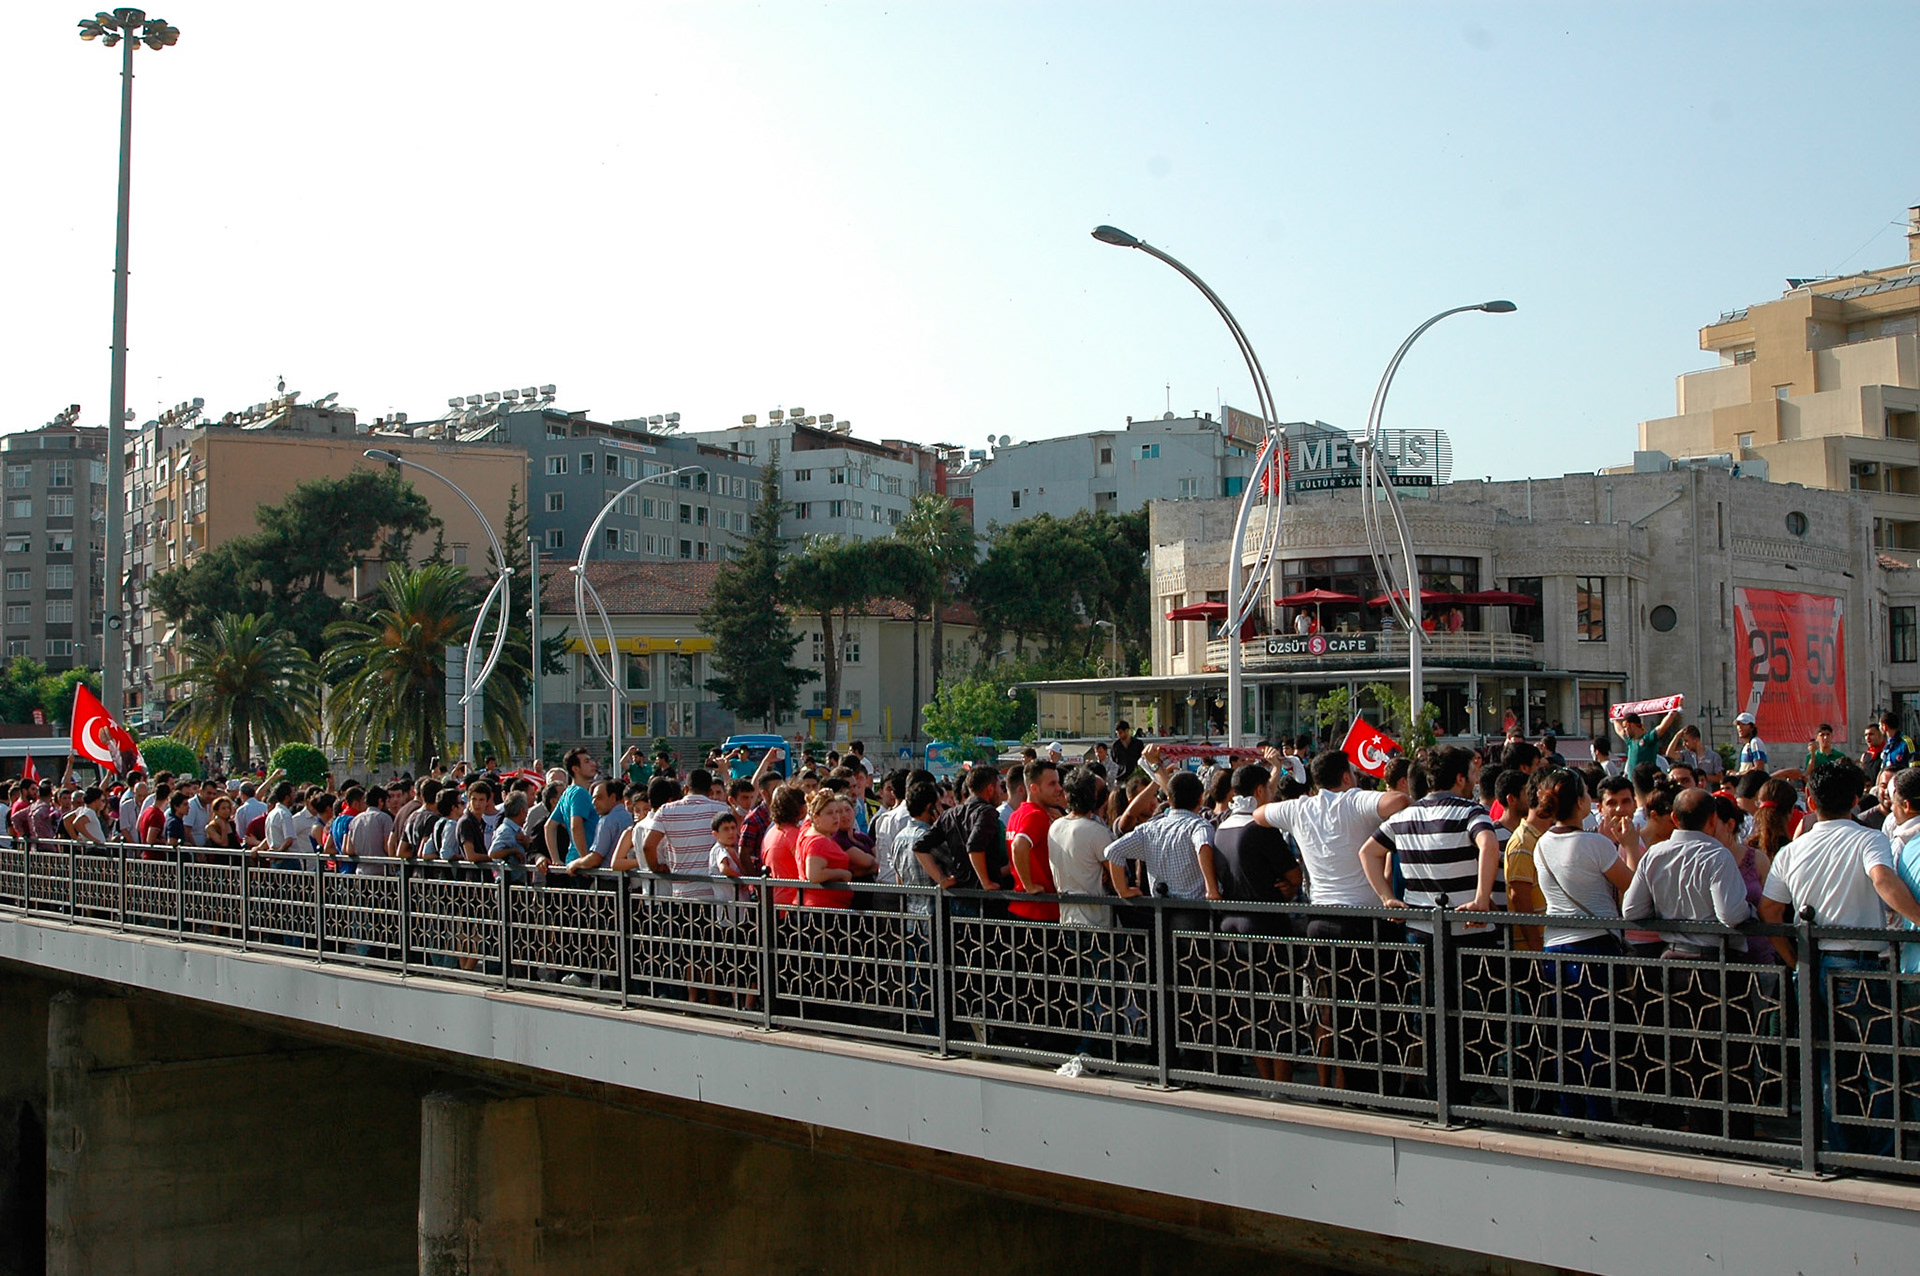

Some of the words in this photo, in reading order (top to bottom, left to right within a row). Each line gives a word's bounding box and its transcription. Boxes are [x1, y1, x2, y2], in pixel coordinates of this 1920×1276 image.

[1299, 474, 1336, 489] KÜLTÜR
[1268, 640, 1308, 654] ÖZSÜT
[1328, 640, 1367, 652] CAFE
[1749, 629, 1791, 683] 25
[1807, 633, 1836, 686] 50
